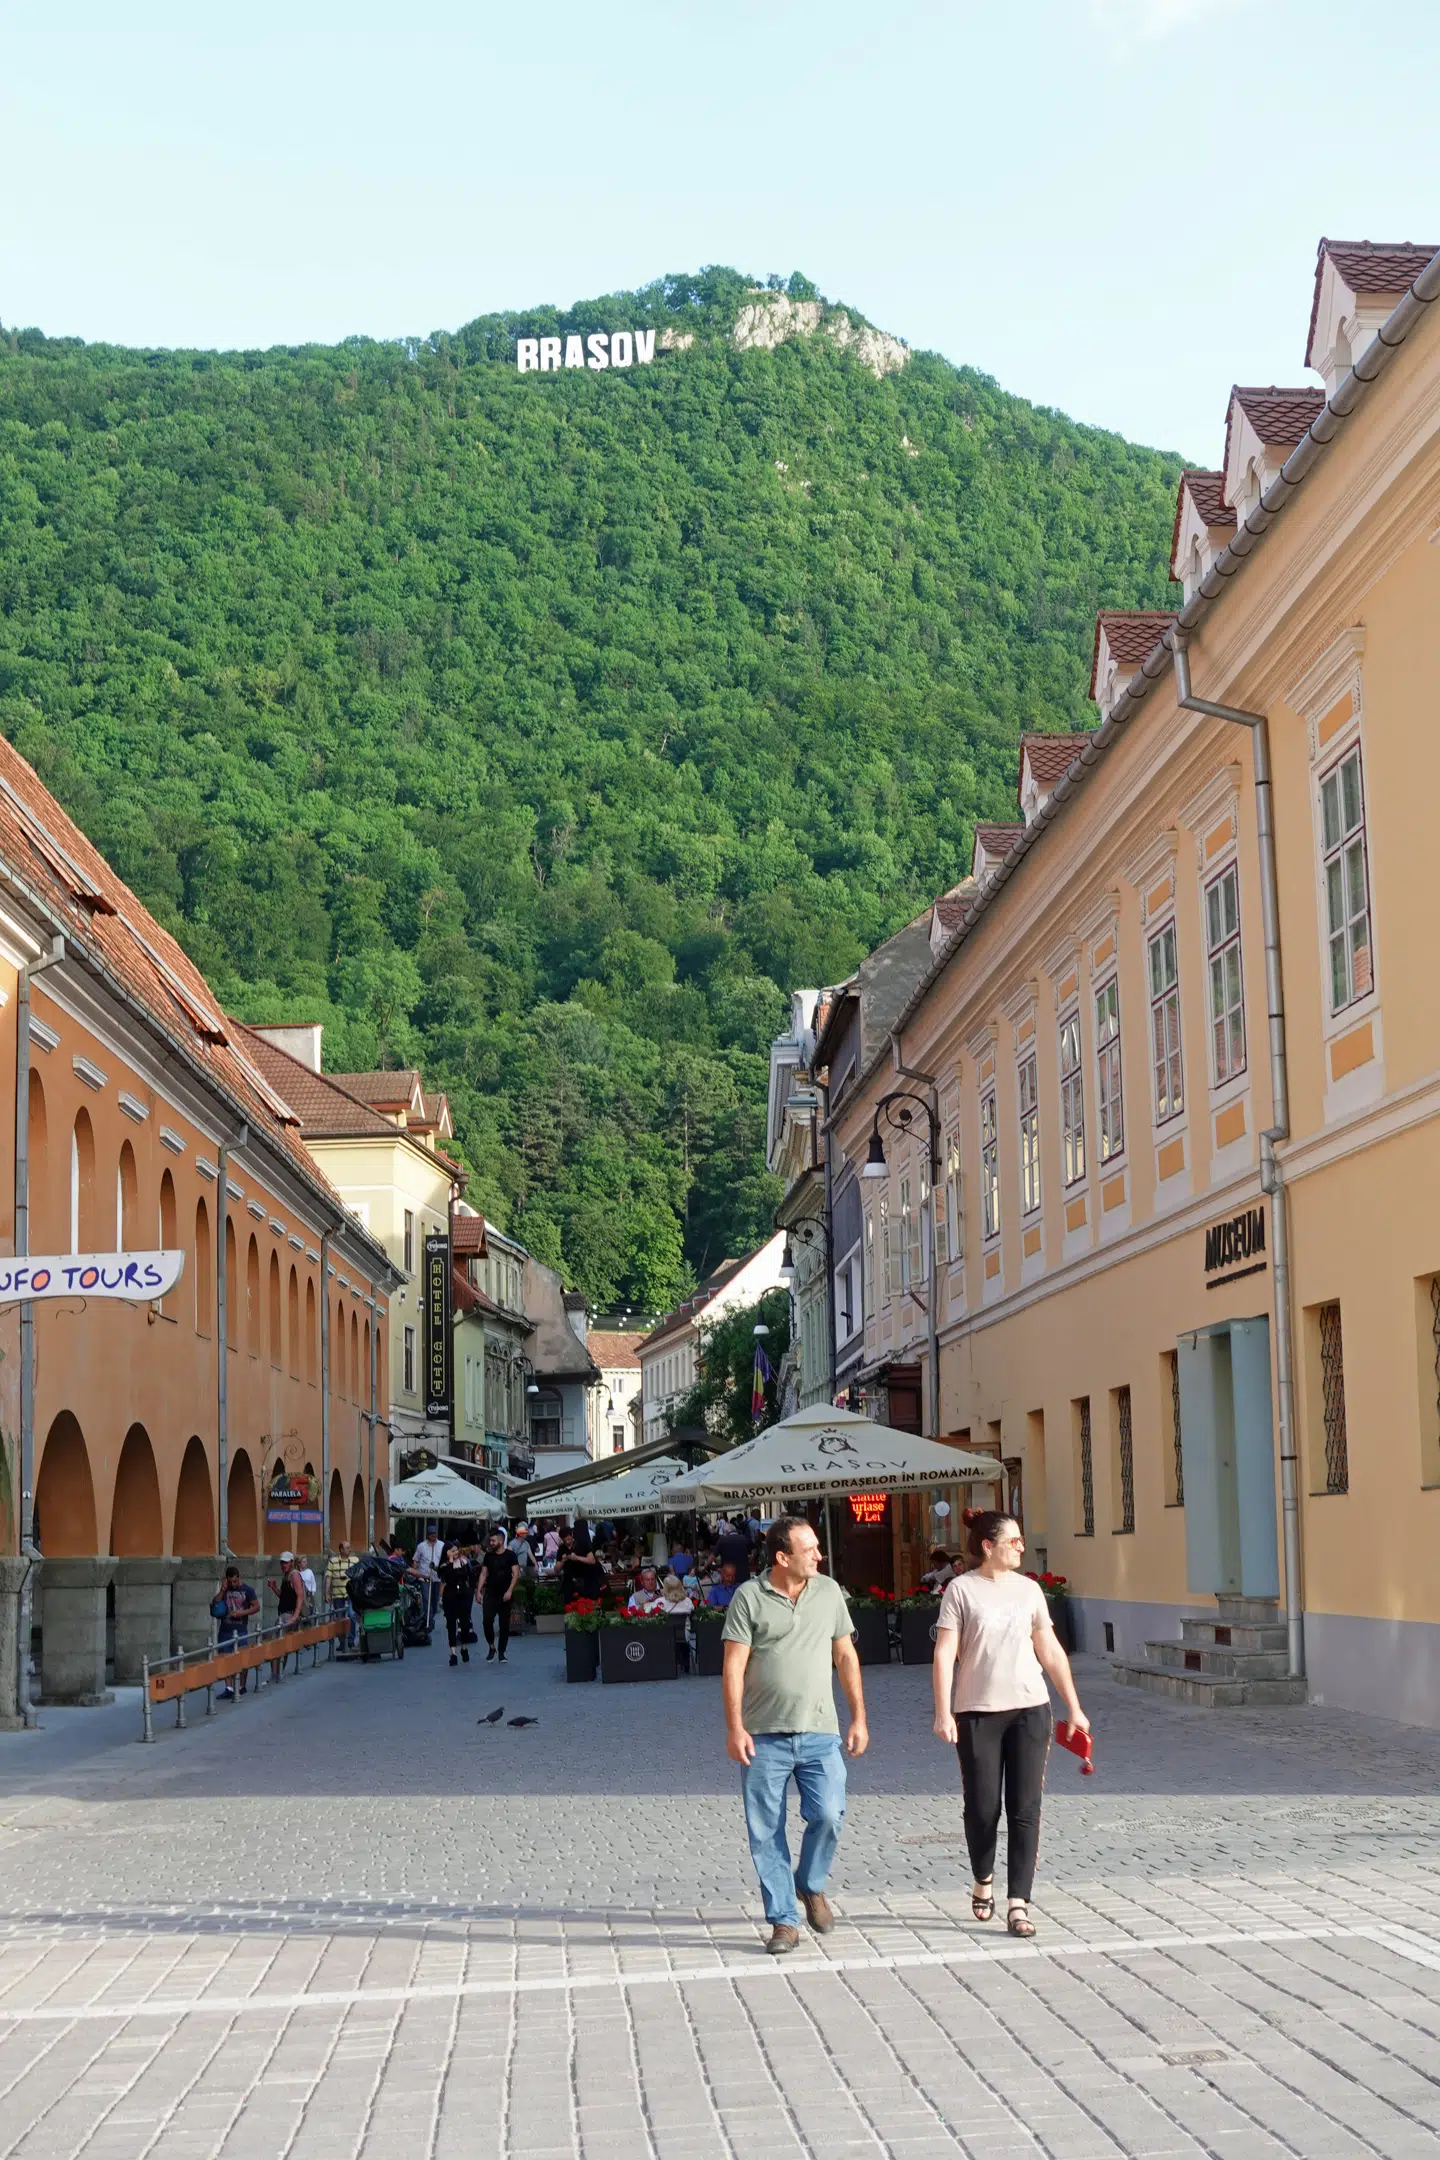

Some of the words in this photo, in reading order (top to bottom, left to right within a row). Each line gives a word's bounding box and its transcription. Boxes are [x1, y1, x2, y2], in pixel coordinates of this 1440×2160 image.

[517, 330, 656, 373] BRASOV
[1204, 1206, 1266, 1272] MUSEUM
[62, 1262, 163, 1289] TOURS
[432, 1264, 442, 1326] HOTEL
[781, 1481, 826, 1493] REGELE
[855, 1511, 862, 1522] 7
[865, 1512, 881, 1522] Lei
